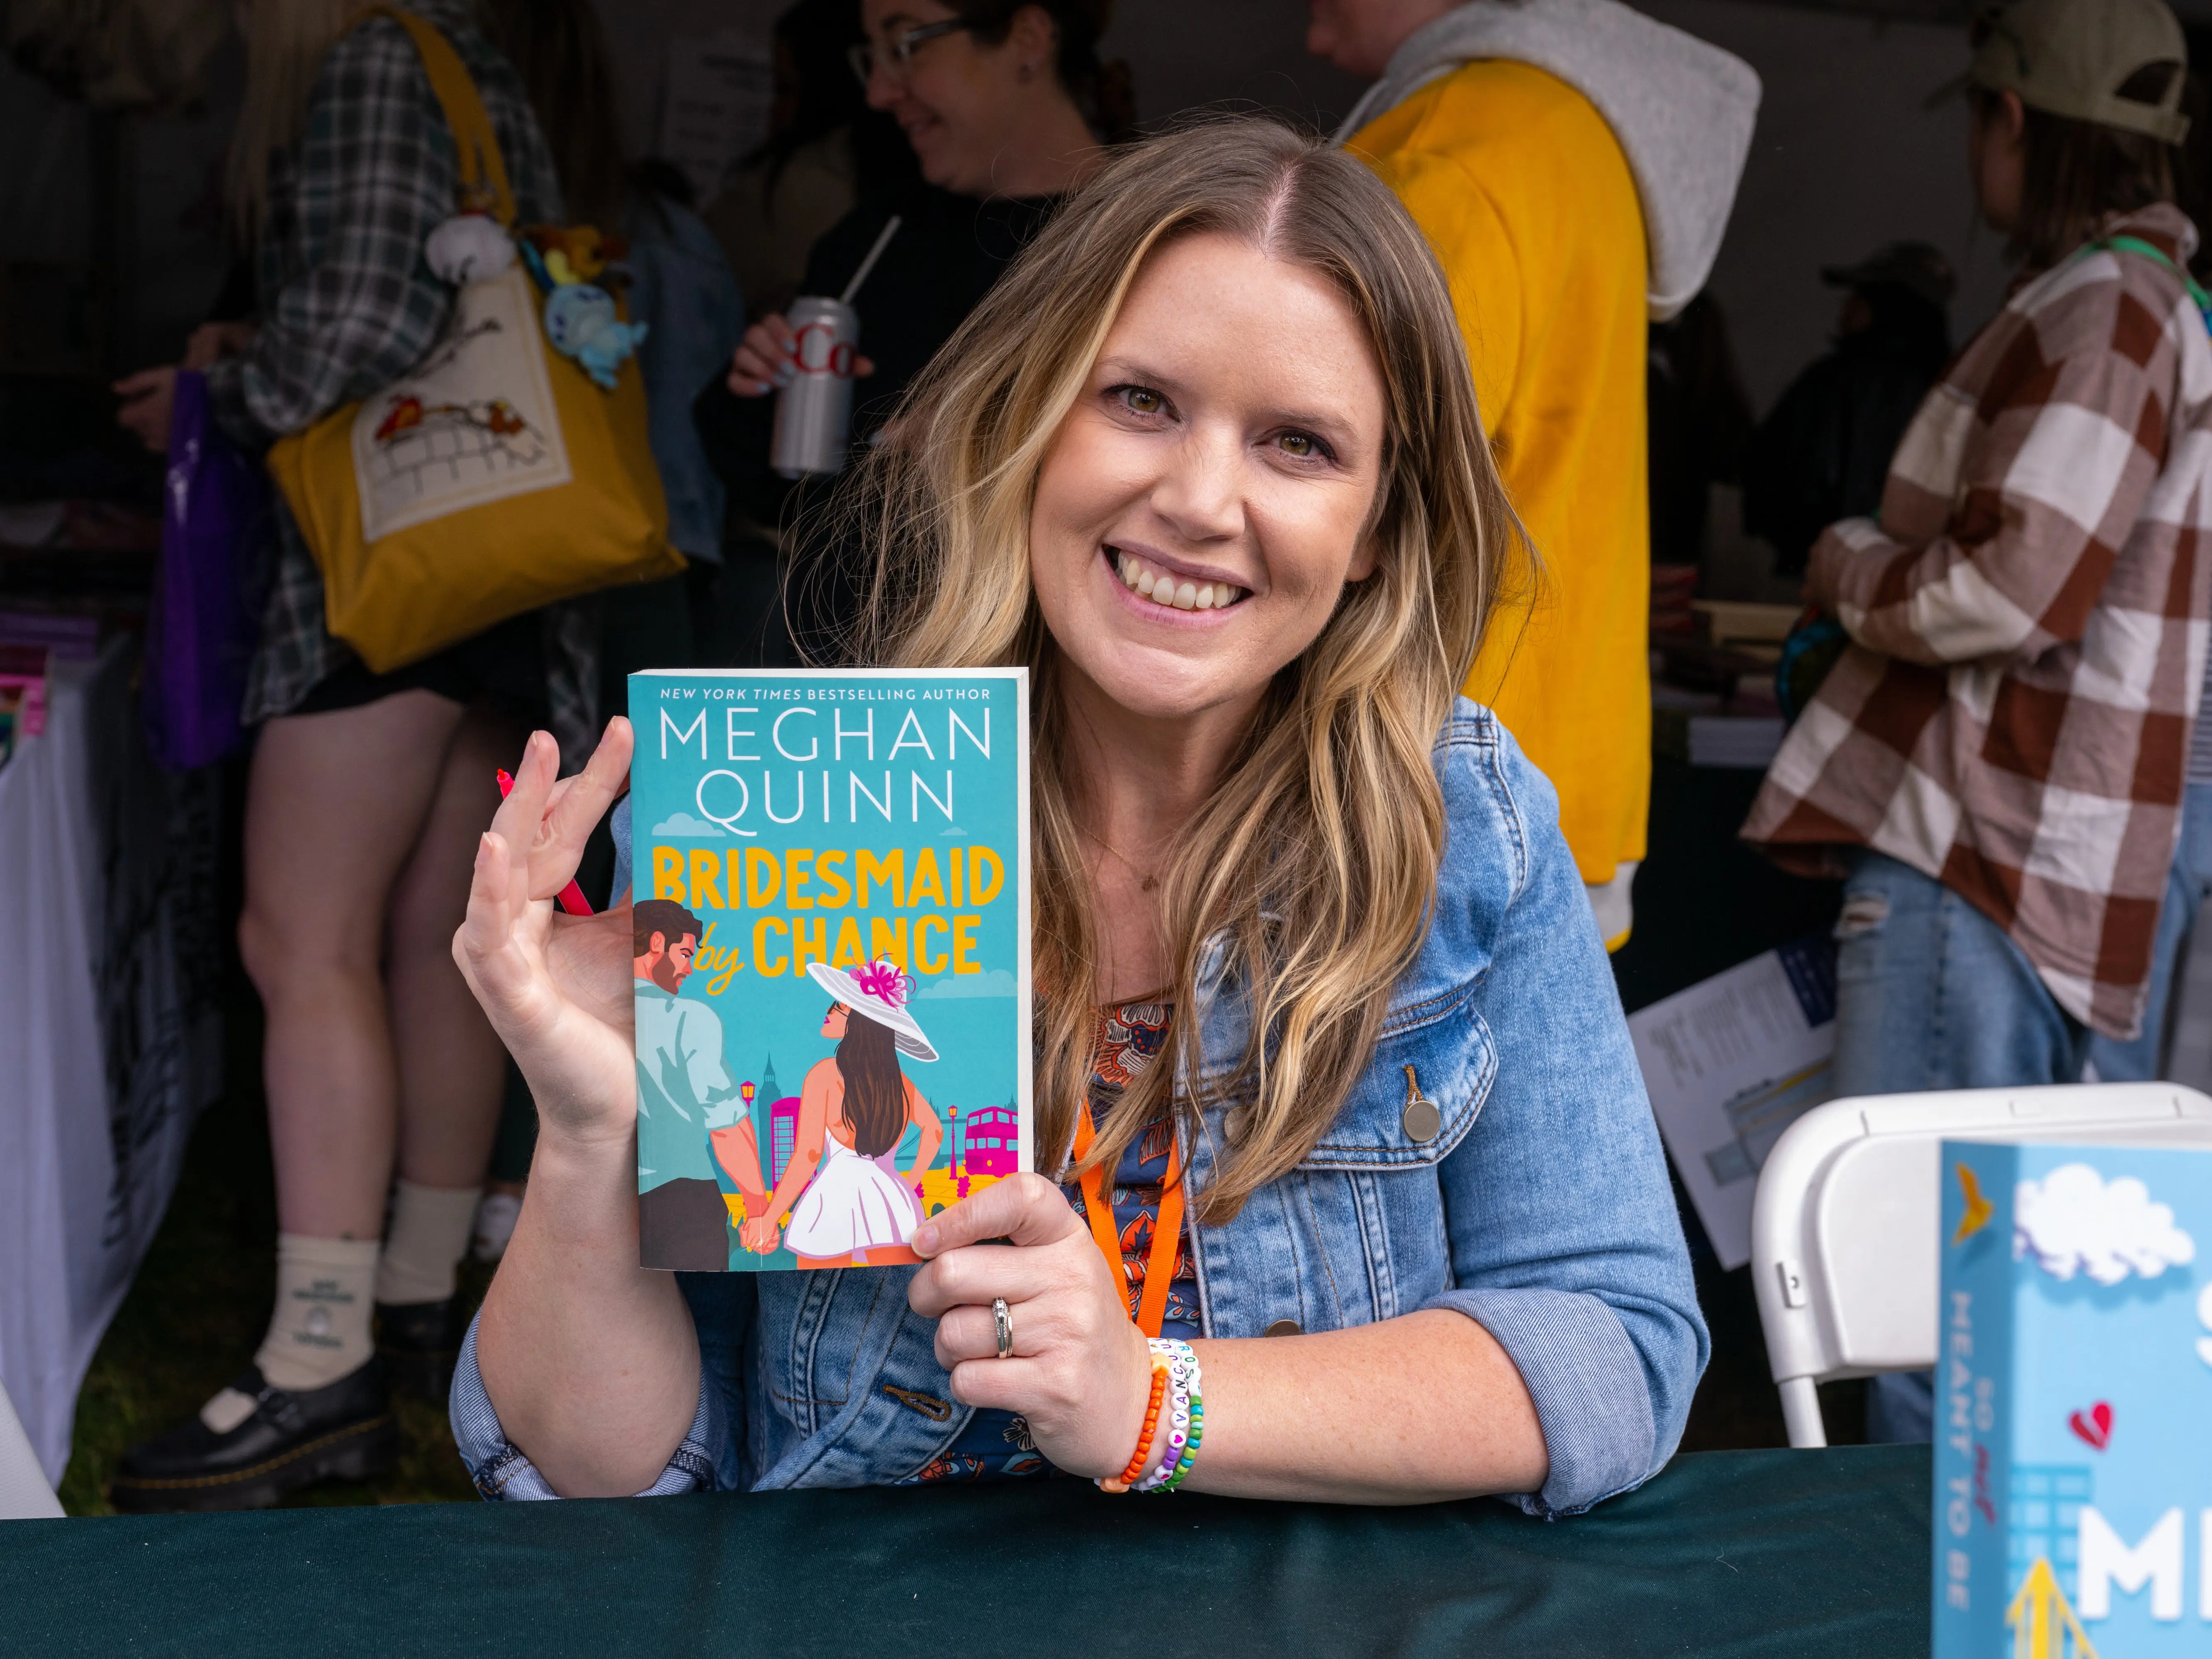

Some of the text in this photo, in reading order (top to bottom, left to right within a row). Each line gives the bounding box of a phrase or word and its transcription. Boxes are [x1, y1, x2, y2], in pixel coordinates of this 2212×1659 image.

[661, 688, 990, 700] NEW YORK TIMES BESTSELLING AUTHOR
[661, 707, 990, 761] MEGHAN
[696, 769, 953, 837] QUINN
[652, 846, 1005, 910] BRIDESMAID
[694, 915, 981, 995] by CHANCE
